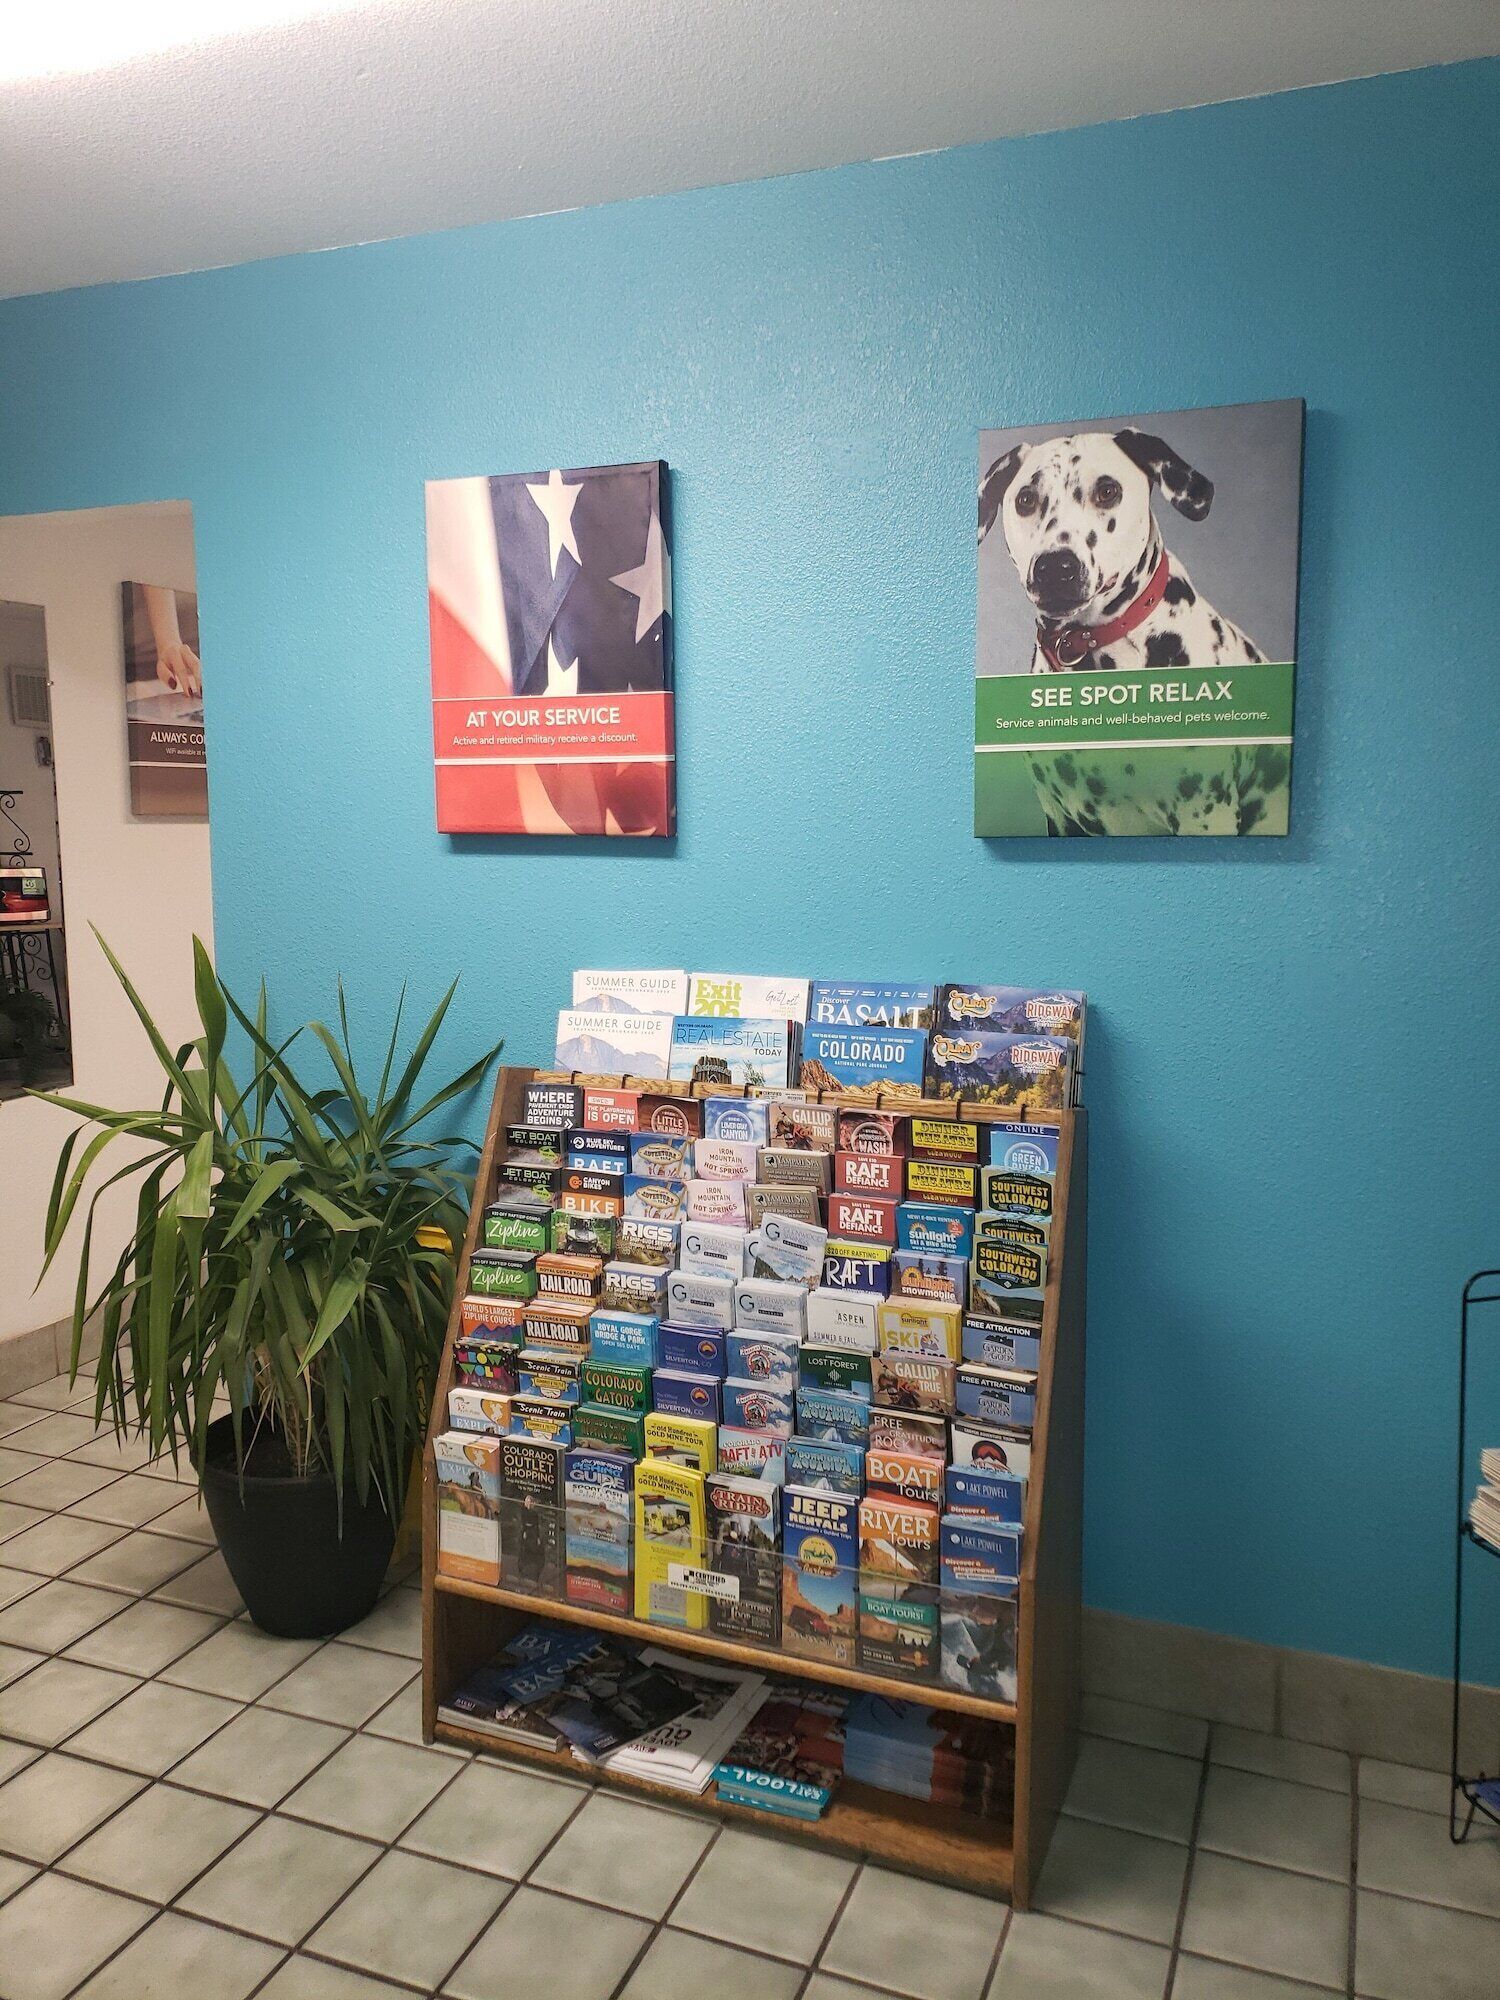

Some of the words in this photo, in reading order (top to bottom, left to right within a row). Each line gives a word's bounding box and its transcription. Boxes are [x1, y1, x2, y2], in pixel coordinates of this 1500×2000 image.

[1031, 687, 1072, 708] SEE
[1080, 684, 1142, 706] SPOT
[1150, 681, 1232, 702] RELAX
[466, 711, 487, 727] AT
[492, 710, 540, 727] YOUR
[545, 707, 620, 726] SERVICE
[996, 718, 1034, 729] Service
[1038, 716, 1078, 727] animals
[1081, 715, 1102, 726] and
[1106, 712, 1181, 724] well-behaved
[1185, 712, 1210, 724] pets
[1214, 710, 1270, 722] welcome.
[150, 731, 187, 743] ALWAYS
[452, 735, 477, 745] Active
[479, 735, 494, 745] and
[496, 735, 523, 744] retired
[525, 734, 555, 746] military
[558, 734, 588, 743] receive
[598, 733, 638, 742] discount.
[586, 977, 634, 988] SUMMER
[640, 978, 677, 989] GUIDE
[696, 979, 743, 1000] Exit
[821, 996, 851, 1004] Discover
[694, 999, 739, 1017] 205
[1027, 1001, 1076, 1018] RIDGWAY
[567, 1016, 617, 1028] SUMMER
[623, 1019, 662, 1030] GUIDE
[816, 1003, 926, 1029] BASALT
[754, 1048, 782, 1056] TODAY
[820, 1040, 904, 1063] COLORADO
[528, 1092, 574, 1103] WHERE
[528, 1109, 574, 1117] ADVENTURE
[600, 1106, 635, 1114] PLAYGROUND
[793, 1109, 831, 1126] GALLUP
[527, 1116, 561, 1125] BEGINS
[588, 1112, 598, 1121] IS
[602, 1113, 635, 1124] OPEN
[657, 1117, 683, 1128] LITTLE
[509, 1131, 527, 1139] JET
[529, 1132, 557, 1141] BOAT
[721, 1129, 748, 1140] CANYON
[921, 1122, 969, 1136] DINNER
[1006, 1124, 1044, 1135] ONLINE
[586, 1143, 625, 1151] ADVENTURES
[859, 1140, 886, 1154] WASH
[915, 1132, 975, 1147] THEATRE
[574, 1158, 624, 1173] RAFT
[710, 1154, 743, 1163] MOUNTAIN
[1012, 1154, 1041, 1165] GREEN
[704, 1162, 717, 1171] HOT
[846, 1160, 890, 1179] RAFT
[583, 1177, 610, 1186] CANYON
[846, 1176, 889, 1188] DEFIANCE
[912, 1175, 971, 1191] THEATRE
[992, 1182, 1048, 1197] SOUTHWEST
[565, 1197, 615, 1214] BIKE
[992, 1193, 1048, 1210] COLORADO
[840, 1206, 884, 1226] RAFT
[489, 1220, 541, 1246] Zipline
[622, 1221, 672, 1242] RIGS
[840, 1221, 883, 1234] DEFIANCE
[909, 1230, 956, 1243] sunlight
[985, 1228, 1041, 1243] SOUTHWEST
[980, 1247, 1037, 1268] SOUTHWEST
[980, 1260, 1037, 1281] COLORADO
[472, 1267, 524, 1292] Zipline
[540, 1274, 591, 1296] RAILROAD
[606, 1273, 656, 1291] RIGS
[902, 1287, 955, 1300] snowmobile
[464, 1312, 489, 1322] ZIPLINE
[490, 1316, 516, 1326] COURSE
[490, 1307, 515, 1316] LARGEST
[838, 1313, 864, 1324] ASPEN
[526, 1320, 579, 1342] RAILROAD
[597, 1323, 618, 1333] ROYAL
[620, 1326, 642, 1336] GORGE
[967, 1320, 984, 1329] FREE
[985, 1323, 1030, 1336] ATTRACTION
[595, 1330, 618, 1340] BRIDGE
[620, 1334, 626, 1342] &
[628, 1335, 646, 1344] PARK
[525, 1361, 551, 1372] Scenic
[551, 1365, 572, 1376] Train
[808, 1358, 828, 1366] LOST
[830, 1360, 859, 1370] FOREST
[895, 1362, 939, 1379] GALLUP
[586, 1370, 642, 1393] COLORADO
[920, 1380, 941, 1392] TRUE
[961, 1376, 979, 1384] FREE
[981, 1379, 1026, 1393] ATTRACTION
[596, 1389, 634, 1408] GATORS
[516, 1403, 543, 1414] Scenic
[544, 1407, 565, 1417] Train
[801, 1403, 861, 1427] AQUARIUM
[874, 1416, 903, 1431] FREE
[647, 1430, 666, 1438] GOLD
[667, 1433, 684, 1442] MINE
[685, 1437, 704, 1446] TOUR
[875, 1435, 910, 1450] ROCK
[889, 1429, 937, 1445] GRATITUDE
[503, 1445, 554, 1462] COLORADO
[721, 1447, 750, 1462] RAFT
[760, 1444, 782, 1458] ATV
[504, 1455, 554, 1473] OUTLET
[573, 1462, 620, 1477] FISHING
[505, 1467, 554, 1484] SHOPPING
[569, 1469, 625, 1490] GUIDE
[869, 1458, 937, 1490] BOAT
[638, 1479, 657, 1488] GOLD
[657, 1483, 676, 1493] MINE
[676, 1488, 694, 1497] TOUR
[896, 1483, 938, 1503] Tours
[966, 1482, 982, 1493] LAKE
[982, 1484, 1008, 1499] POWELL
[720, 1490, 765, 1506] TRAIN
[719, 1500, 765, 1515] RIDES
[791, 1496, 847, 1520] JEEP
[951, 1505, 980, 1515] Discover
[789, 1512, 848, 1533] RENTALS
[859, 1508, 931, 1538] RIVER
[888, 1532, 931, 1550] Tours
[960, 1536, 977, 1549] LAKE
[977, 1538, 1002, 1553] POWELL
[695, 1572, 726, 1584] CERTIFIED
[953, 1566, 996, 1575] playground
[867, 1603, 889, 1614] BOAT
[891, 1608, 924, 1620] TOURS!
